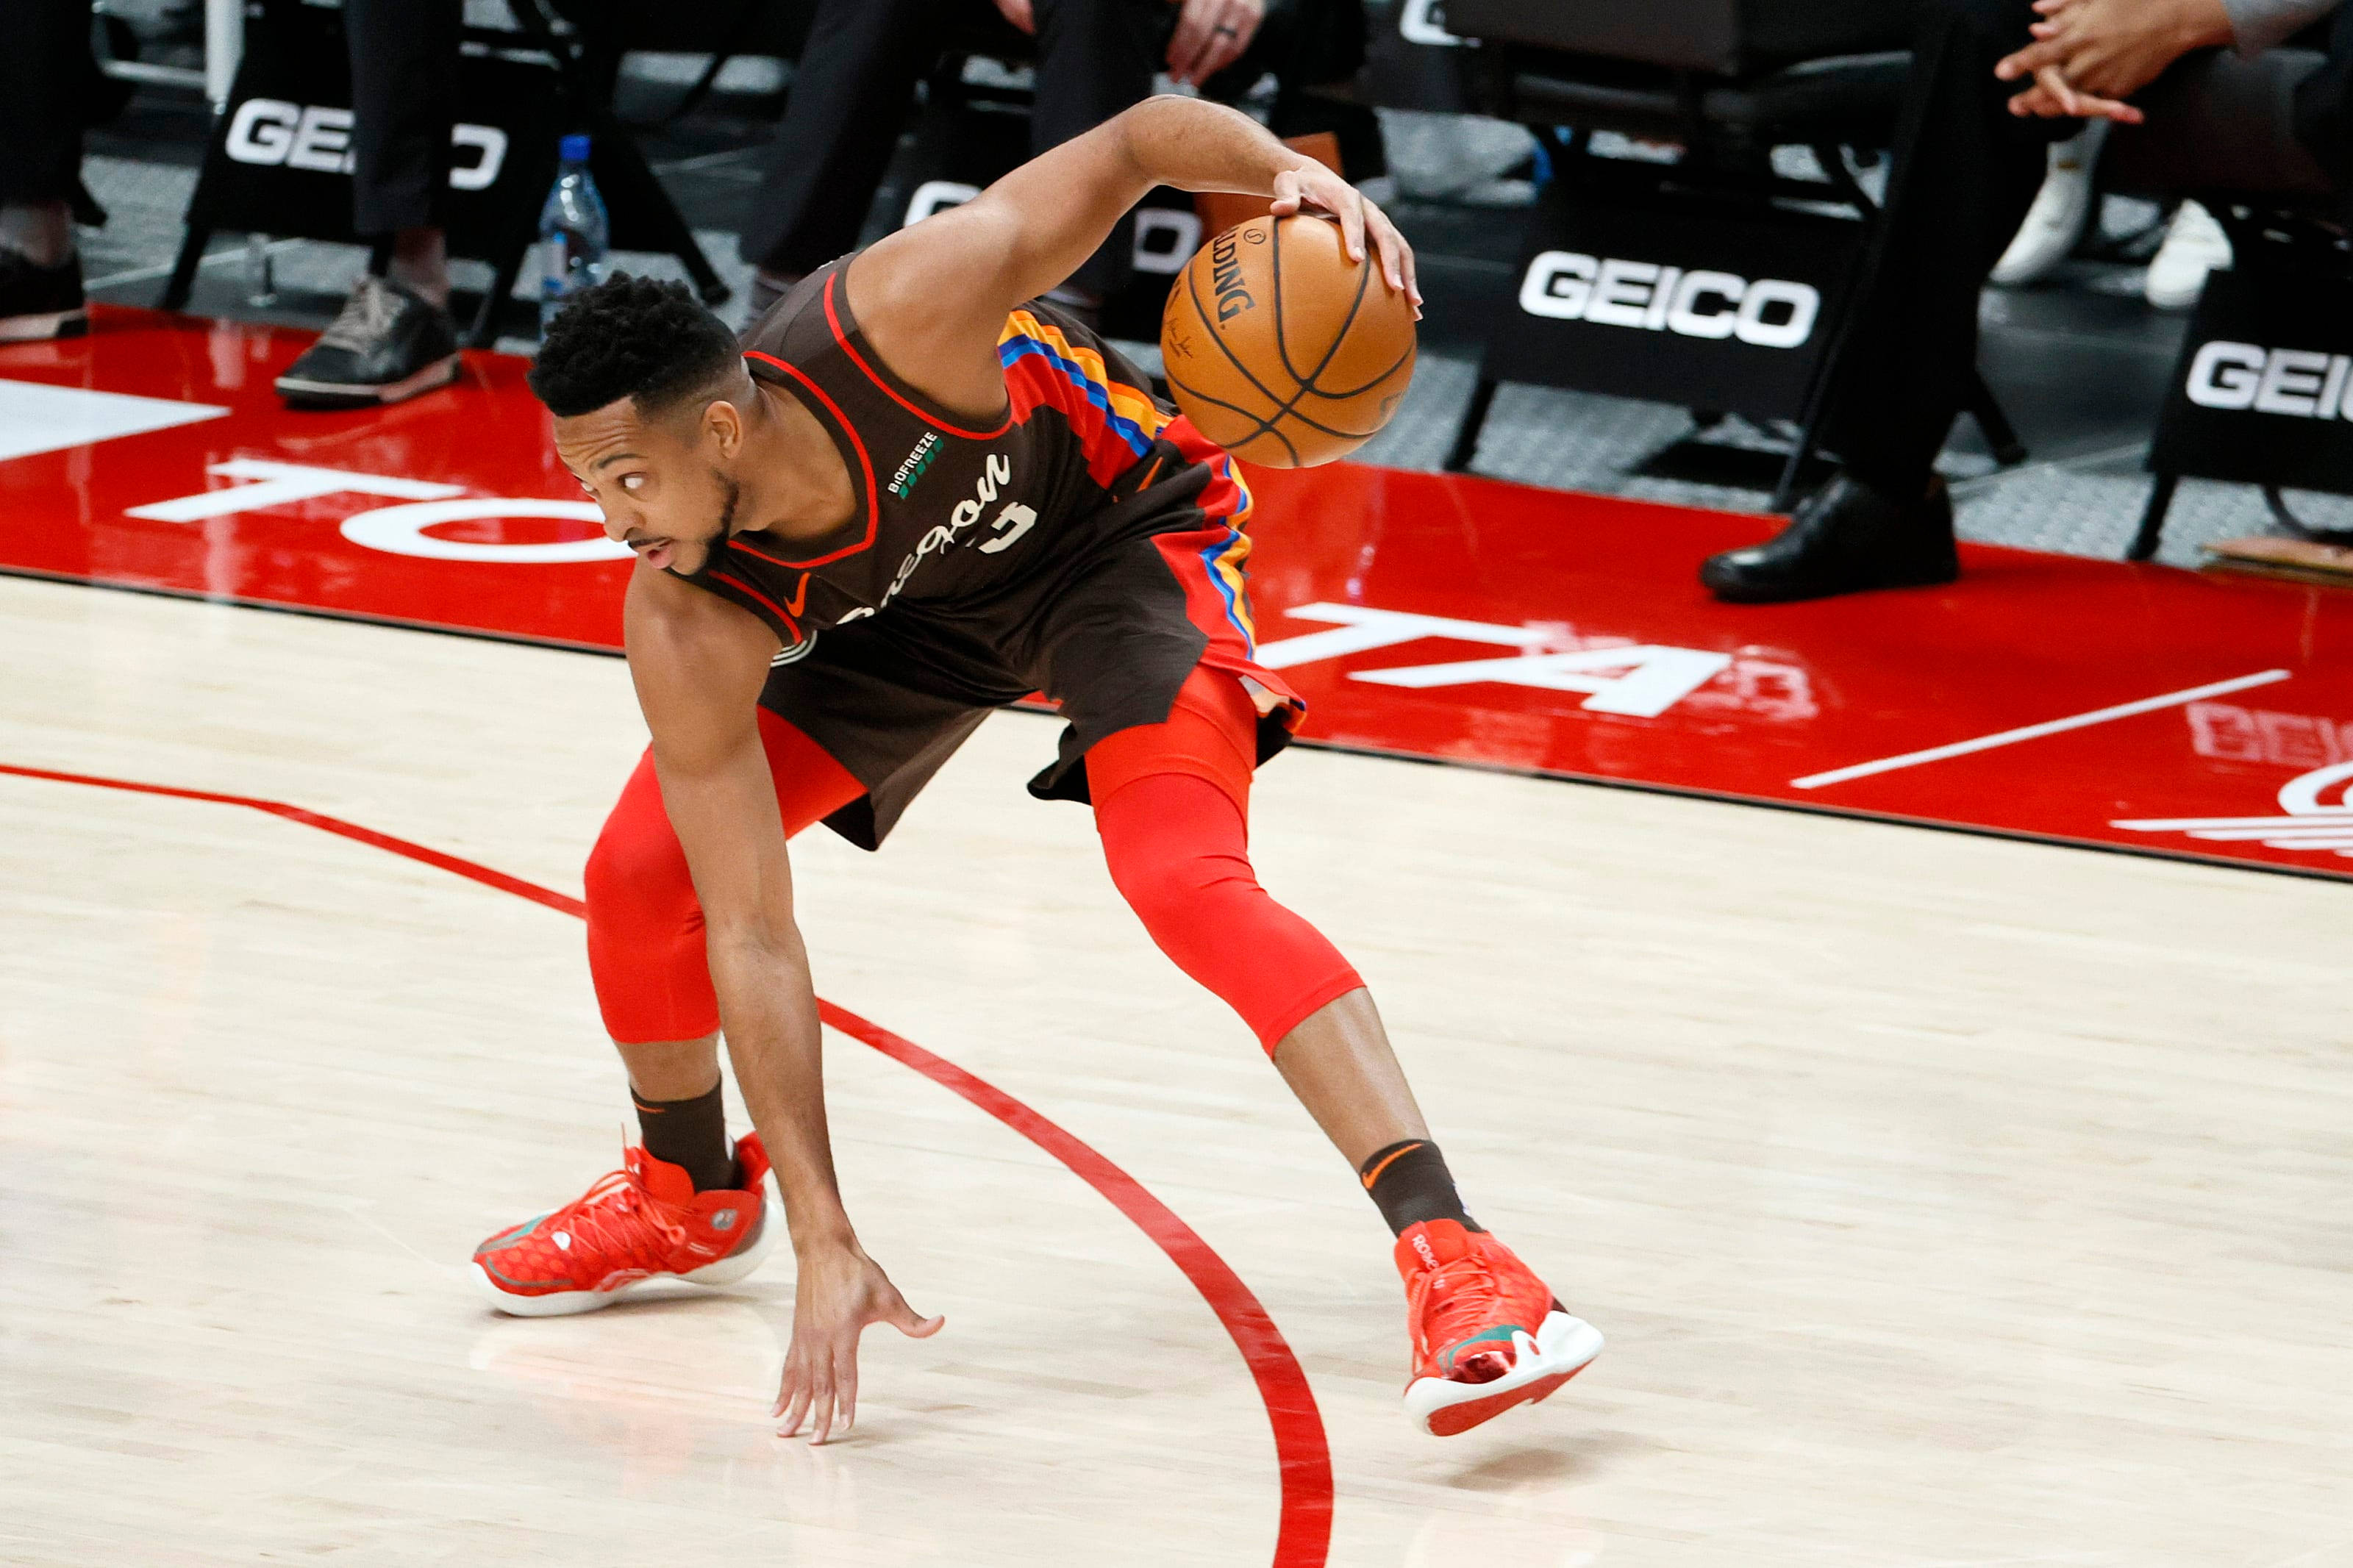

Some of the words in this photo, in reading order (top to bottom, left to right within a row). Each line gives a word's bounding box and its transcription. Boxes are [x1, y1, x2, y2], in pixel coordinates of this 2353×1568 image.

[225, 98, 509, 191] GEO
[1518, 250, 1821, 349] GEICO
[2185, 340, 2353, 423] GEI
[887, 432, 939, 494] BIOFREEZE
